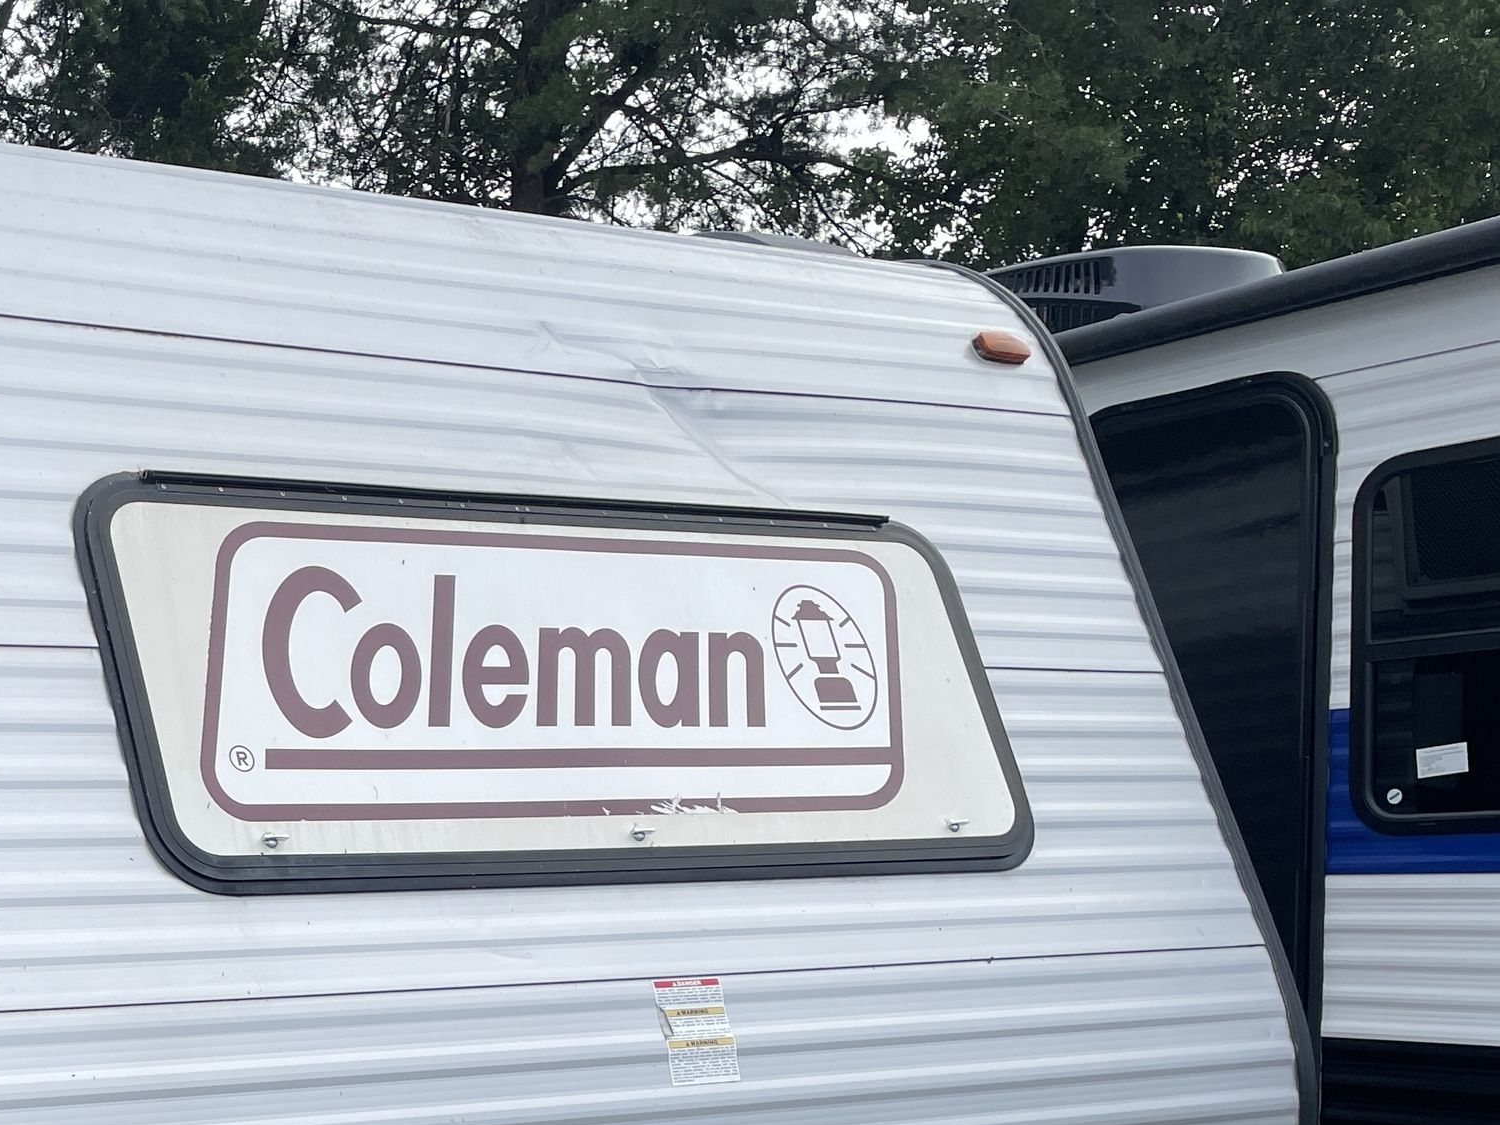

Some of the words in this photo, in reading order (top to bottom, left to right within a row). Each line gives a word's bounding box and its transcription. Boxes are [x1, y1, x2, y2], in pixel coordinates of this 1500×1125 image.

[262, 565, 766, 739] Coleman
[681, 1008, 710, 1016] WARNING
[689, 1039, 719, 1047] WARNING
